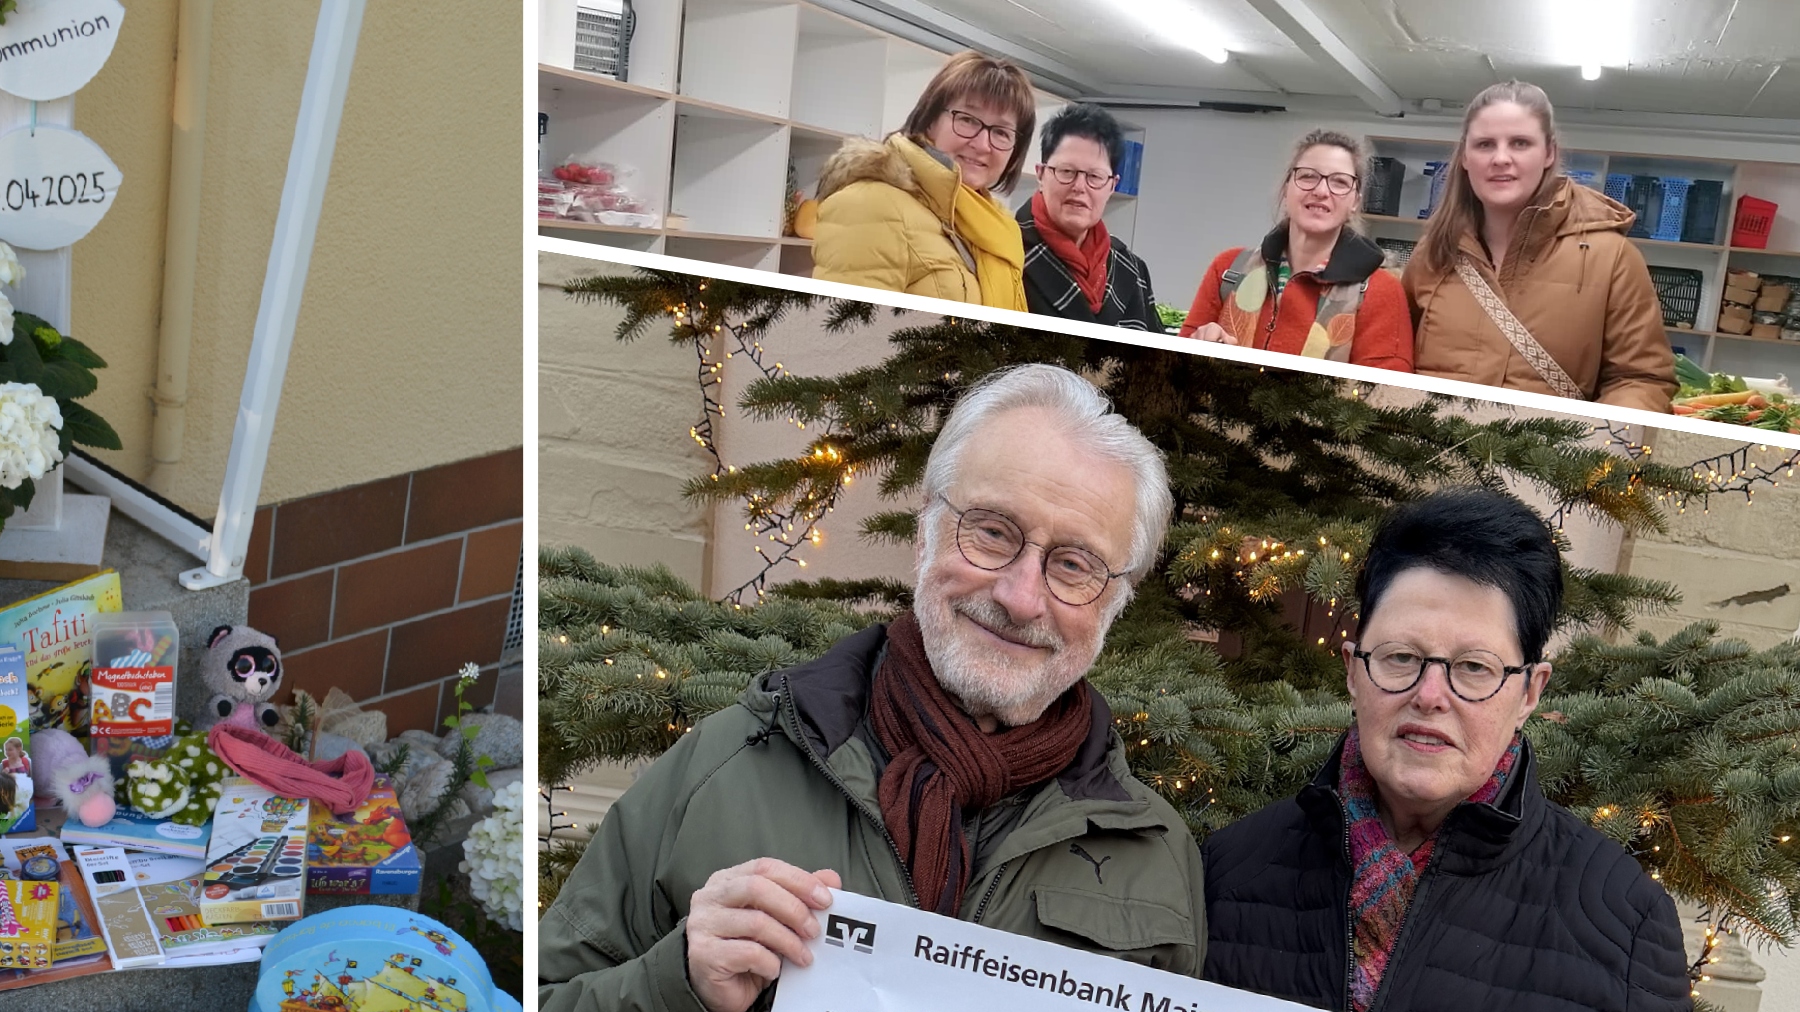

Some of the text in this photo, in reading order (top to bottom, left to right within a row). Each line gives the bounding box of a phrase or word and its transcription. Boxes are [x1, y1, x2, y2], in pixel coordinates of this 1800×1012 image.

[22, 608, 89, 654] Tafiti
[97, 670, 167, 683] Magnetbuchstaben
[375, 868, 419, 877] Ravensburger
[913, 934, 1131, 1012] Raiffeisenbank
